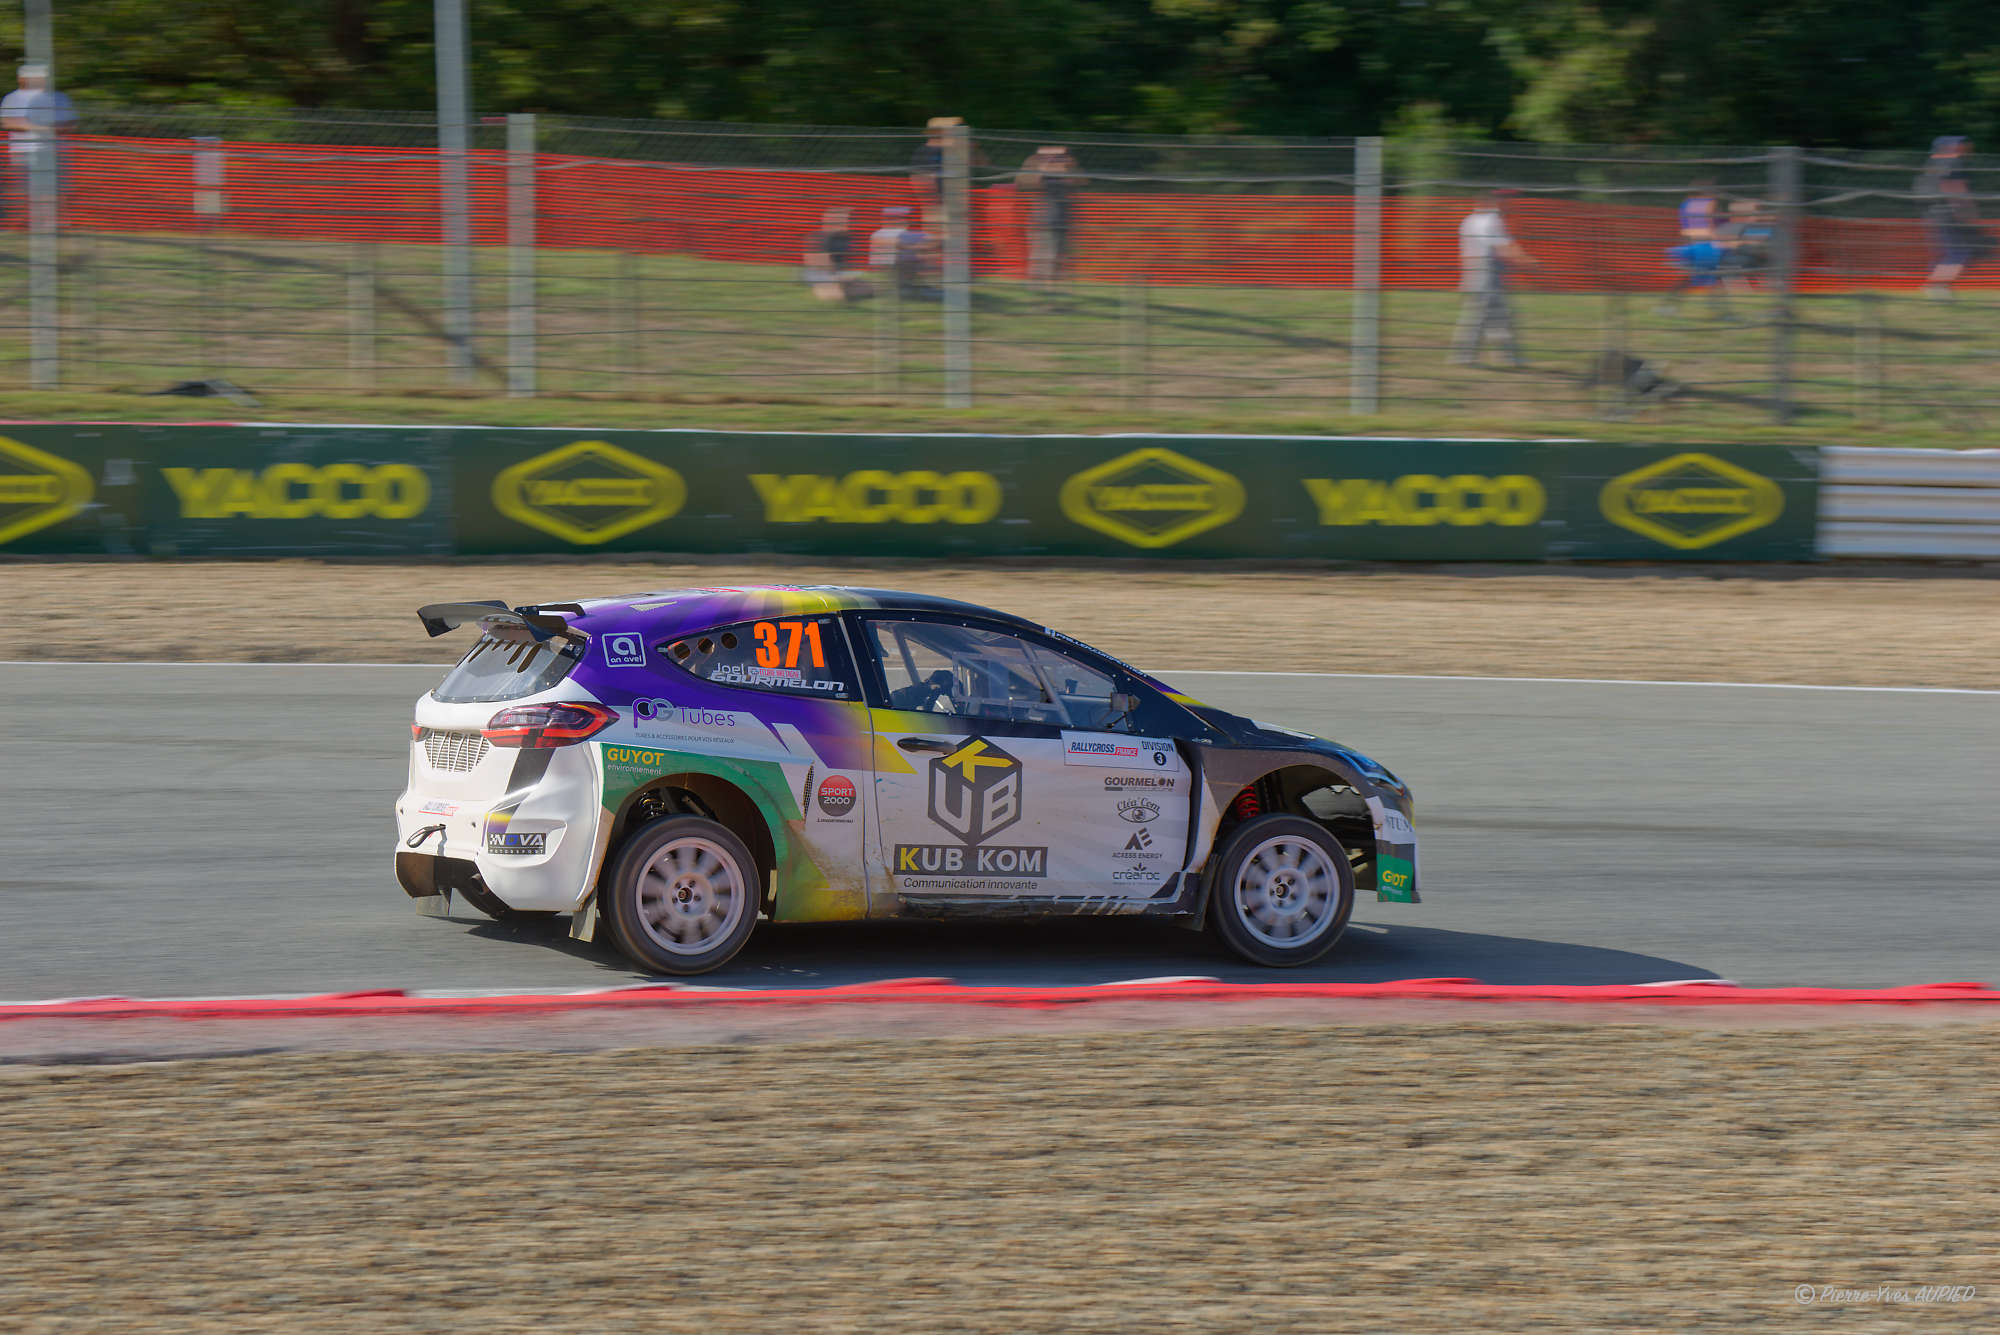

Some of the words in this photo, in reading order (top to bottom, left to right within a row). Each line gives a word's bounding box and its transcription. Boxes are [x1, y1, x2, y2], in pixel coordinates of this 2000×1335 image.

[162, 463, 430, 518] YACCO
[750, 470, 1001, 524] YACCO
[1304, 474, 1545, 525] YACCO
[754, 622, 825, 668] 371
[713, 662, 745, 675] Joel
[710, 673, 844, 691] GOURMELON
[680, 706, 735, 727] Tubes
[1071, 741, 1116, 753] RALLYCROSS
[1142, 741, 1175, 753] DIVISION
[607, 748, 664, 766] GUYOT
[607, 764, 662, 775] environnement
[822, 787, 853, 796] SPORT
[823, 796, 850, 805] 2000
[900, 848, 964, 871] KUB
[977, 849, 1042, 872] KOM
[904, 878, 986, 889] Communication
[988, 879, 1038, 889] innovante
